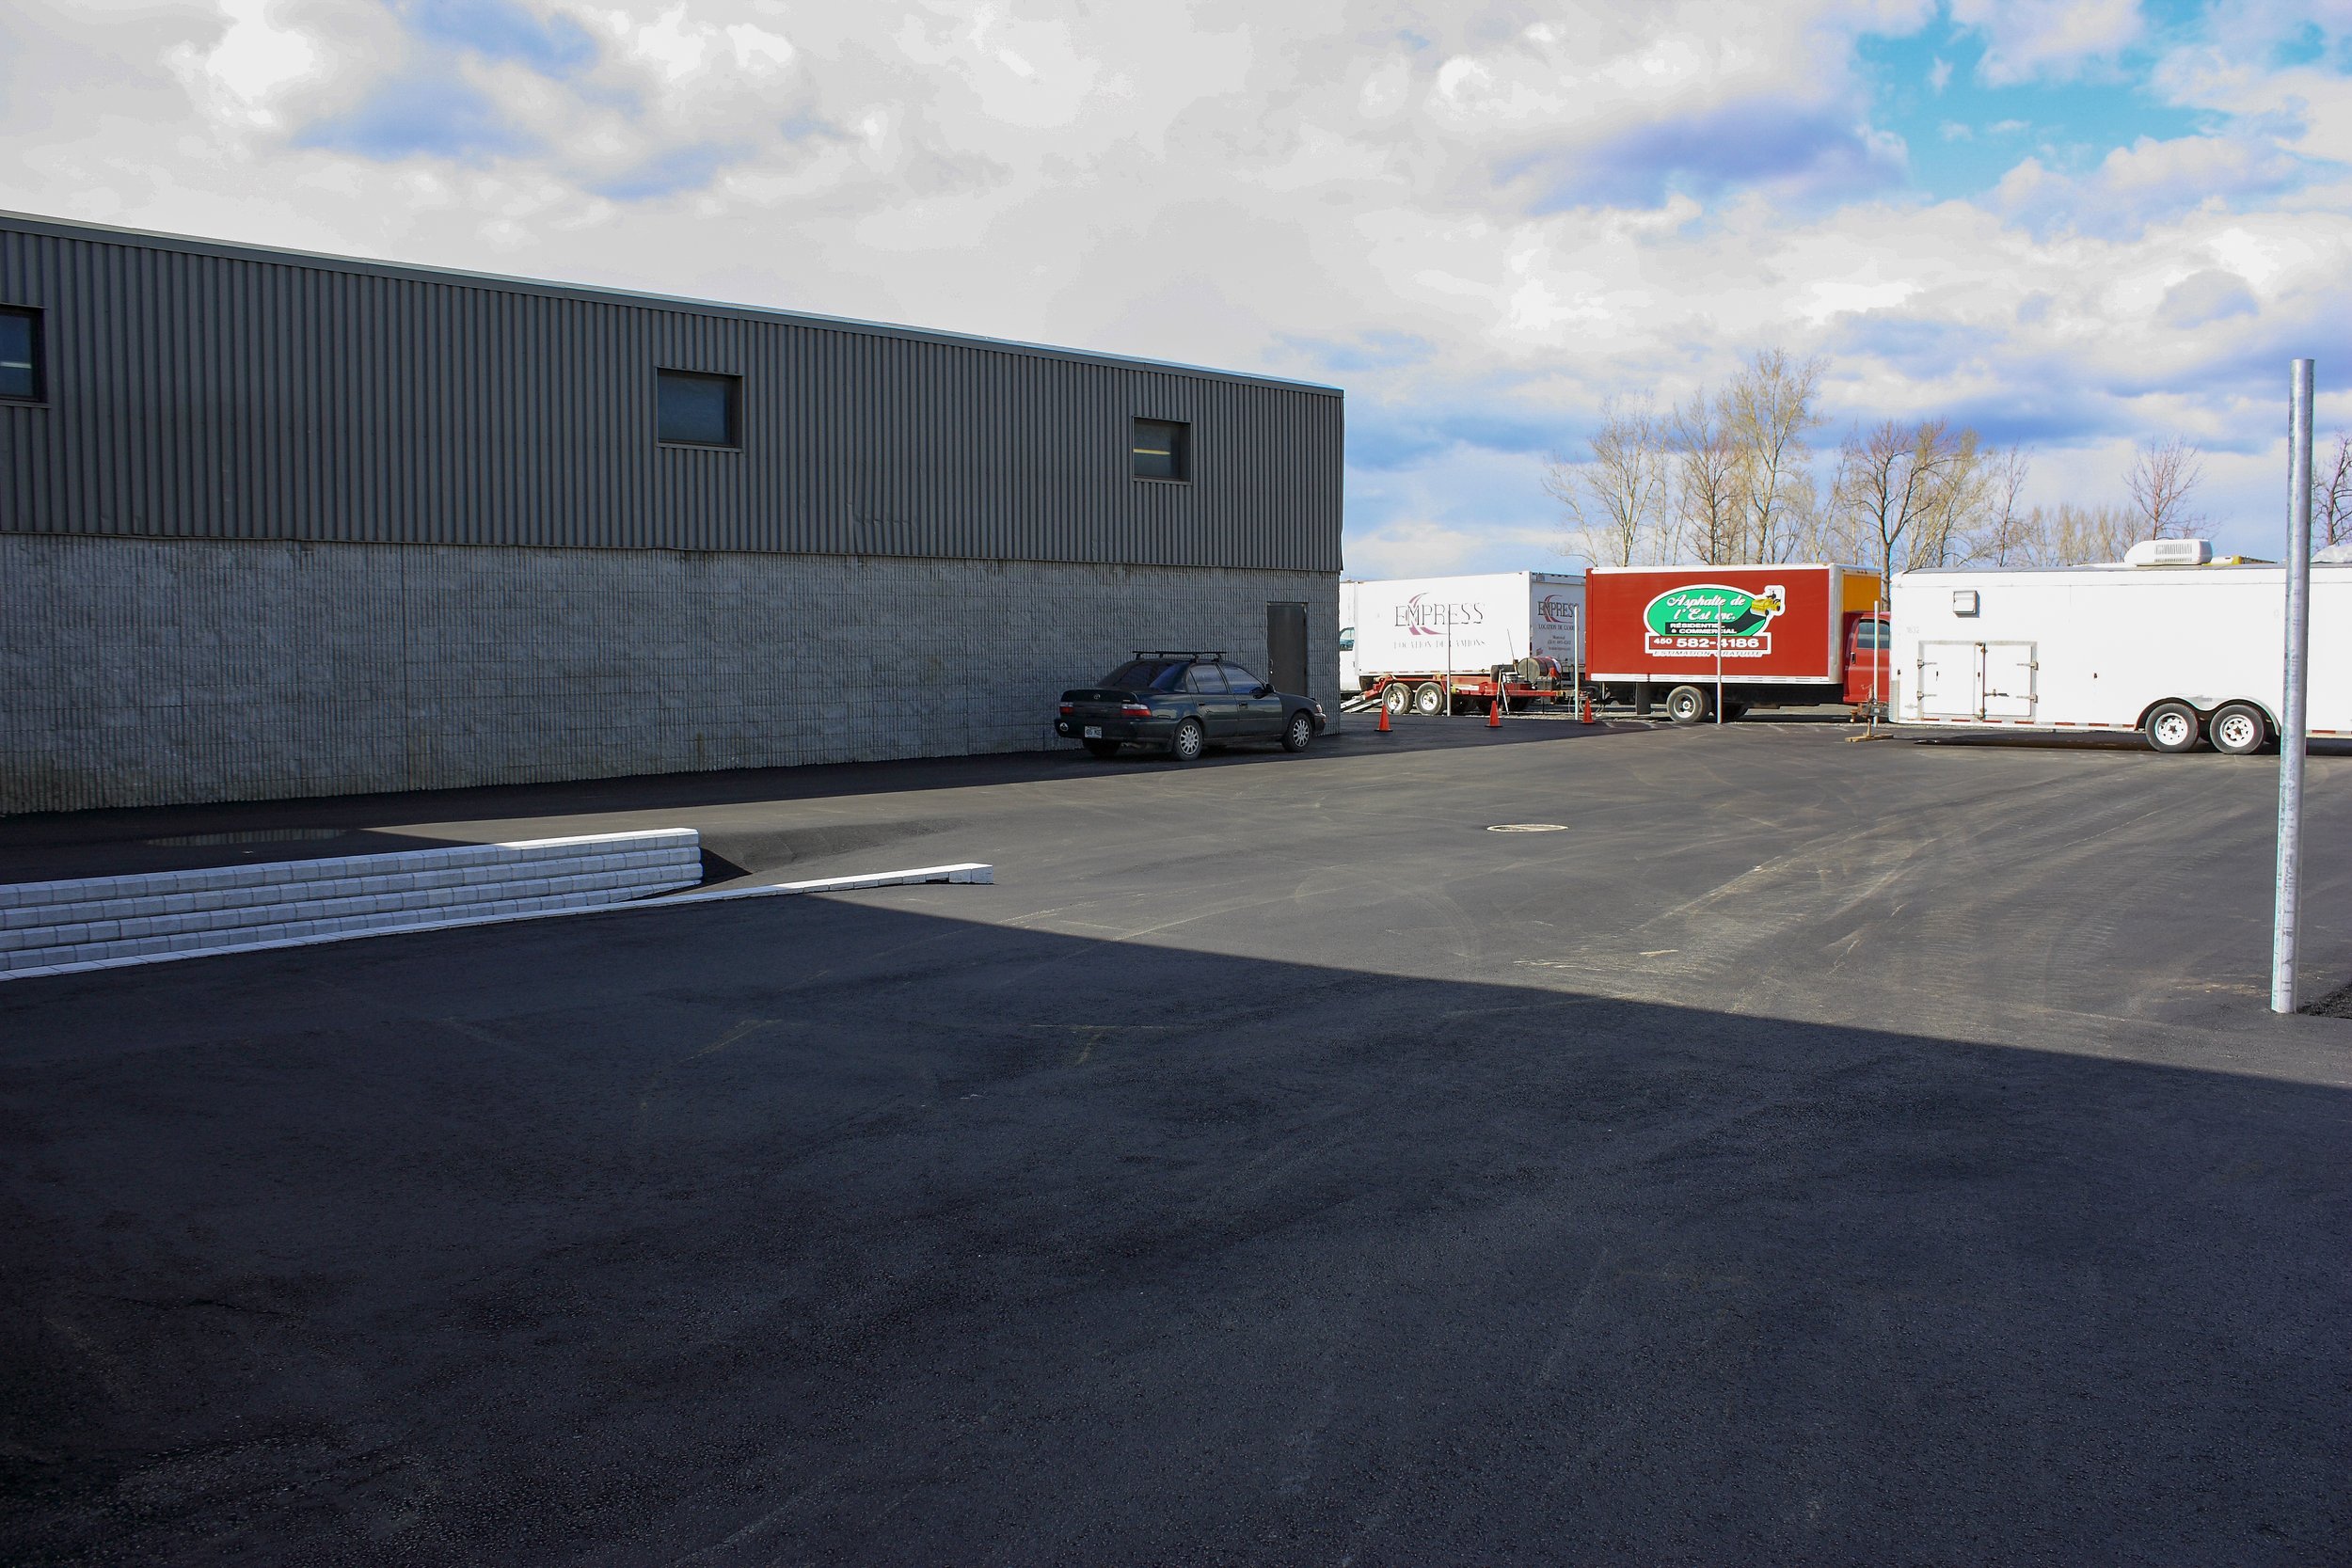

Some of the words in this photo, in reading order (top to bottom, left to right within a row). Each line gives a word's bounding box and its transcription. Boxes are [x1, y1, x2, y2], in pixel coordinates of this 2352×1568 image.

[1666, 594, 1726, 609] Asphalte
[1730, 594, 1746, 607] de
[1394, 603, 1484, 626] EMPRESS
[1676, 638, 1759, 648] 582-4186
